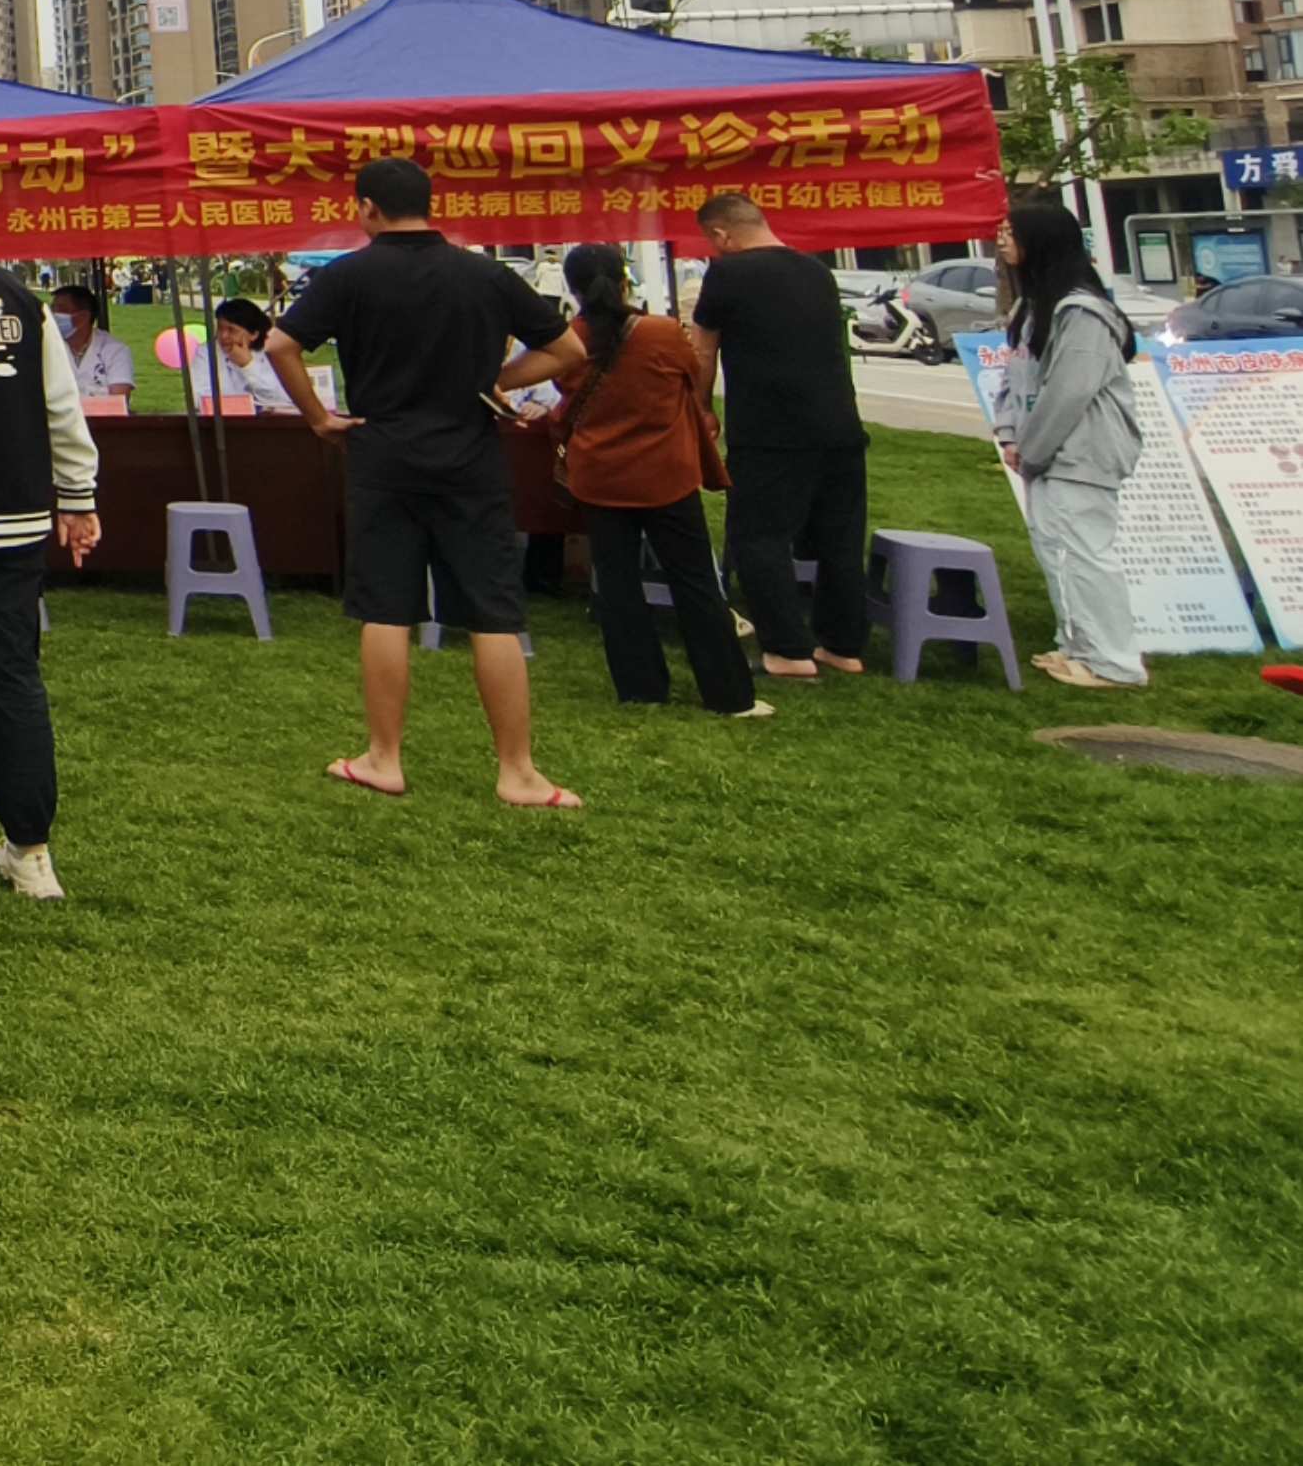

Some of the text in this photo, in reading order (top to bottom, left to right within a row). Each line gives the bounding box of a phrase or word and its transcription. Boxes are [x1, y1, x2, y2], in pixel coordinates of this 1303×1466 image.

[7, 198, 294, 233] 永州市第三人民医院
[310, 189, 582, 223] 永肤病医院
[601, 181, 944, 214] 冷水滩妇幼保健院
